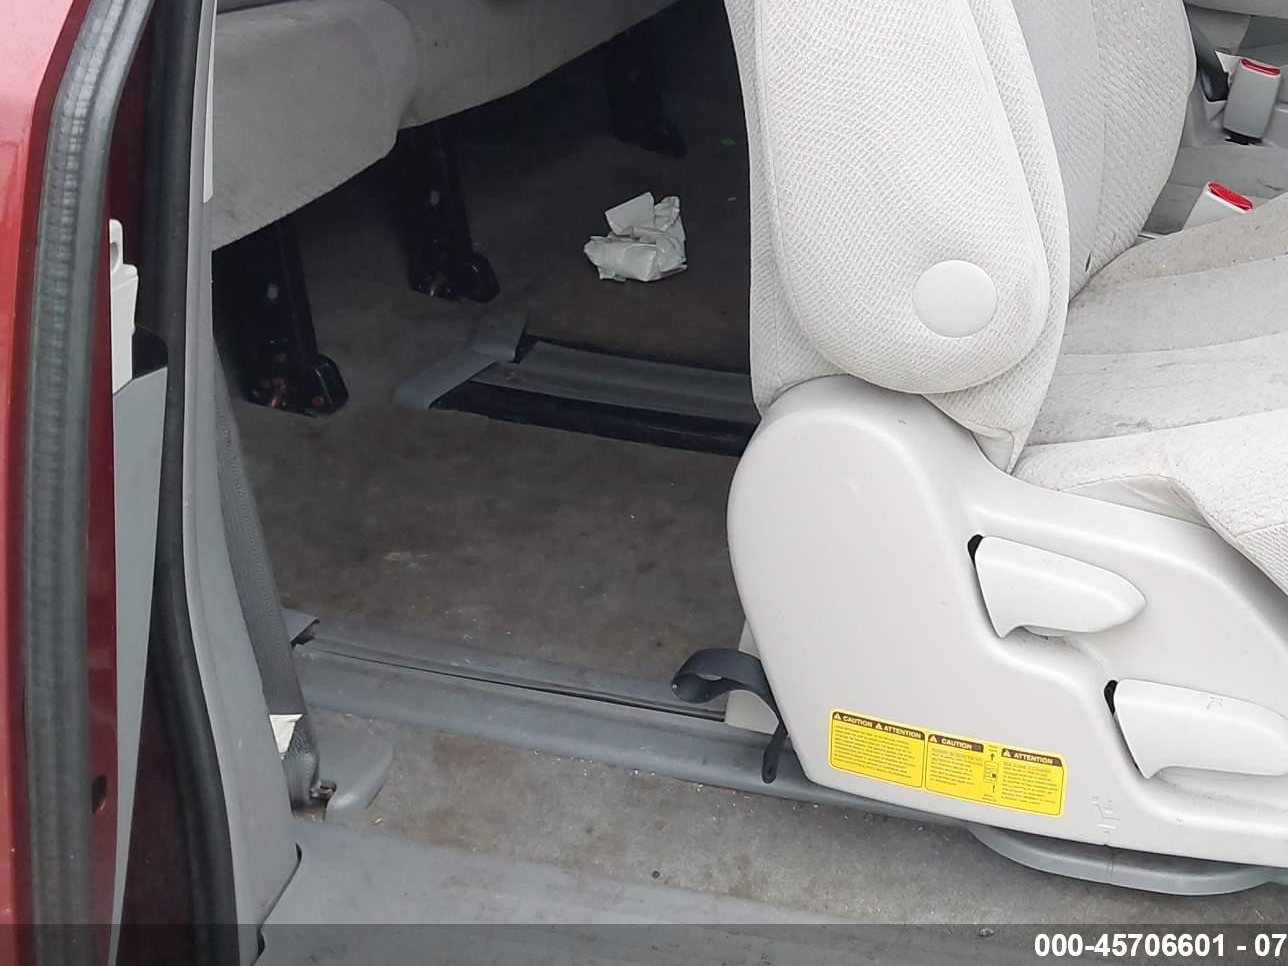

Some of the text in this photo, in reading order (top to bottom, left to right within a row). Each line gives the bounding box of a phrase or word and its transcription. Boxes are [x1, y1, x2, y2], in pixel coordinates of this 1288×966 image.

[842, 715, 922, 739] CAUTION ATTENTION
[940, 737, 973, 751] CAUTION
[1013, 752, 1054, 766] ATTENTION
